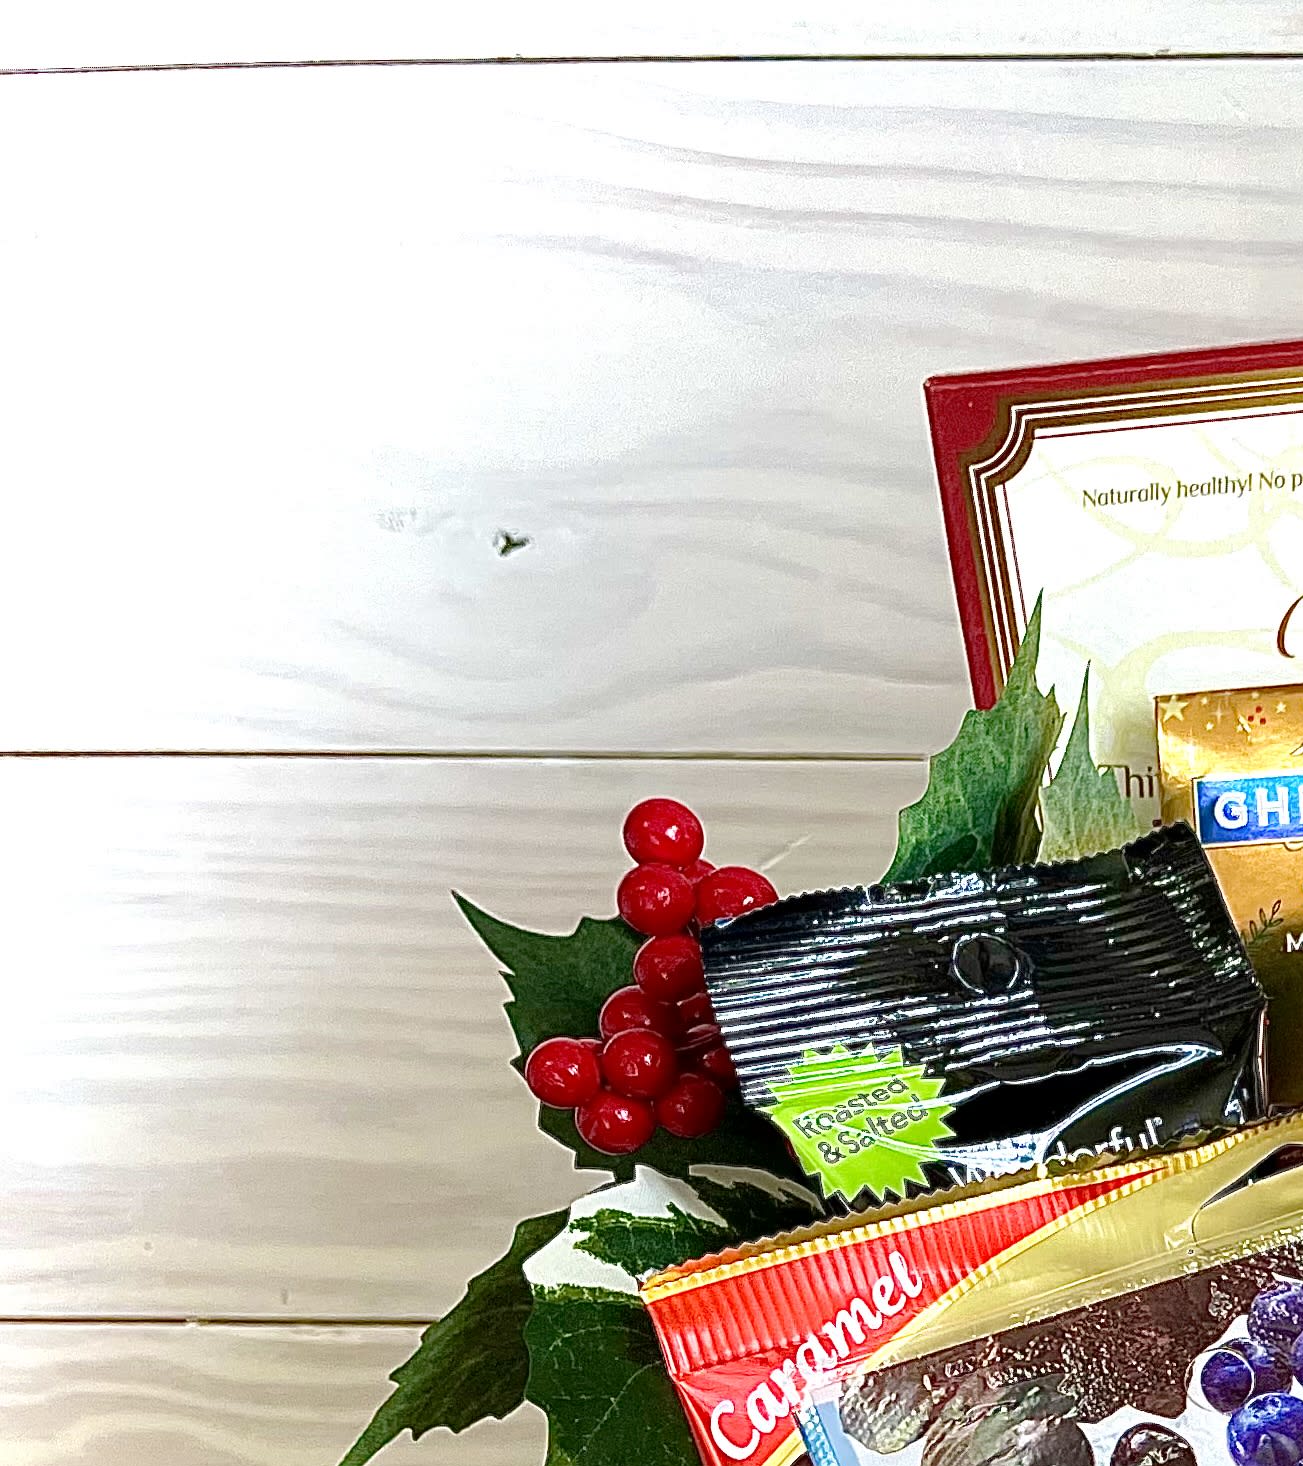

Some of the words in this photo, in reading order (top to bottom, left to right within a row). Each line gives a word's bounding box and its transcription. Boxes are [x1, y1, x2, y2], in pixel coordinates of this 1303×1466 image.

[1083, 483, 1171, 508] Naturally
[1177, 473, 1252, 498] healthy!
[1259, 471, 1285, 491] No
[710, 1250, 923, 1461] Caramel
